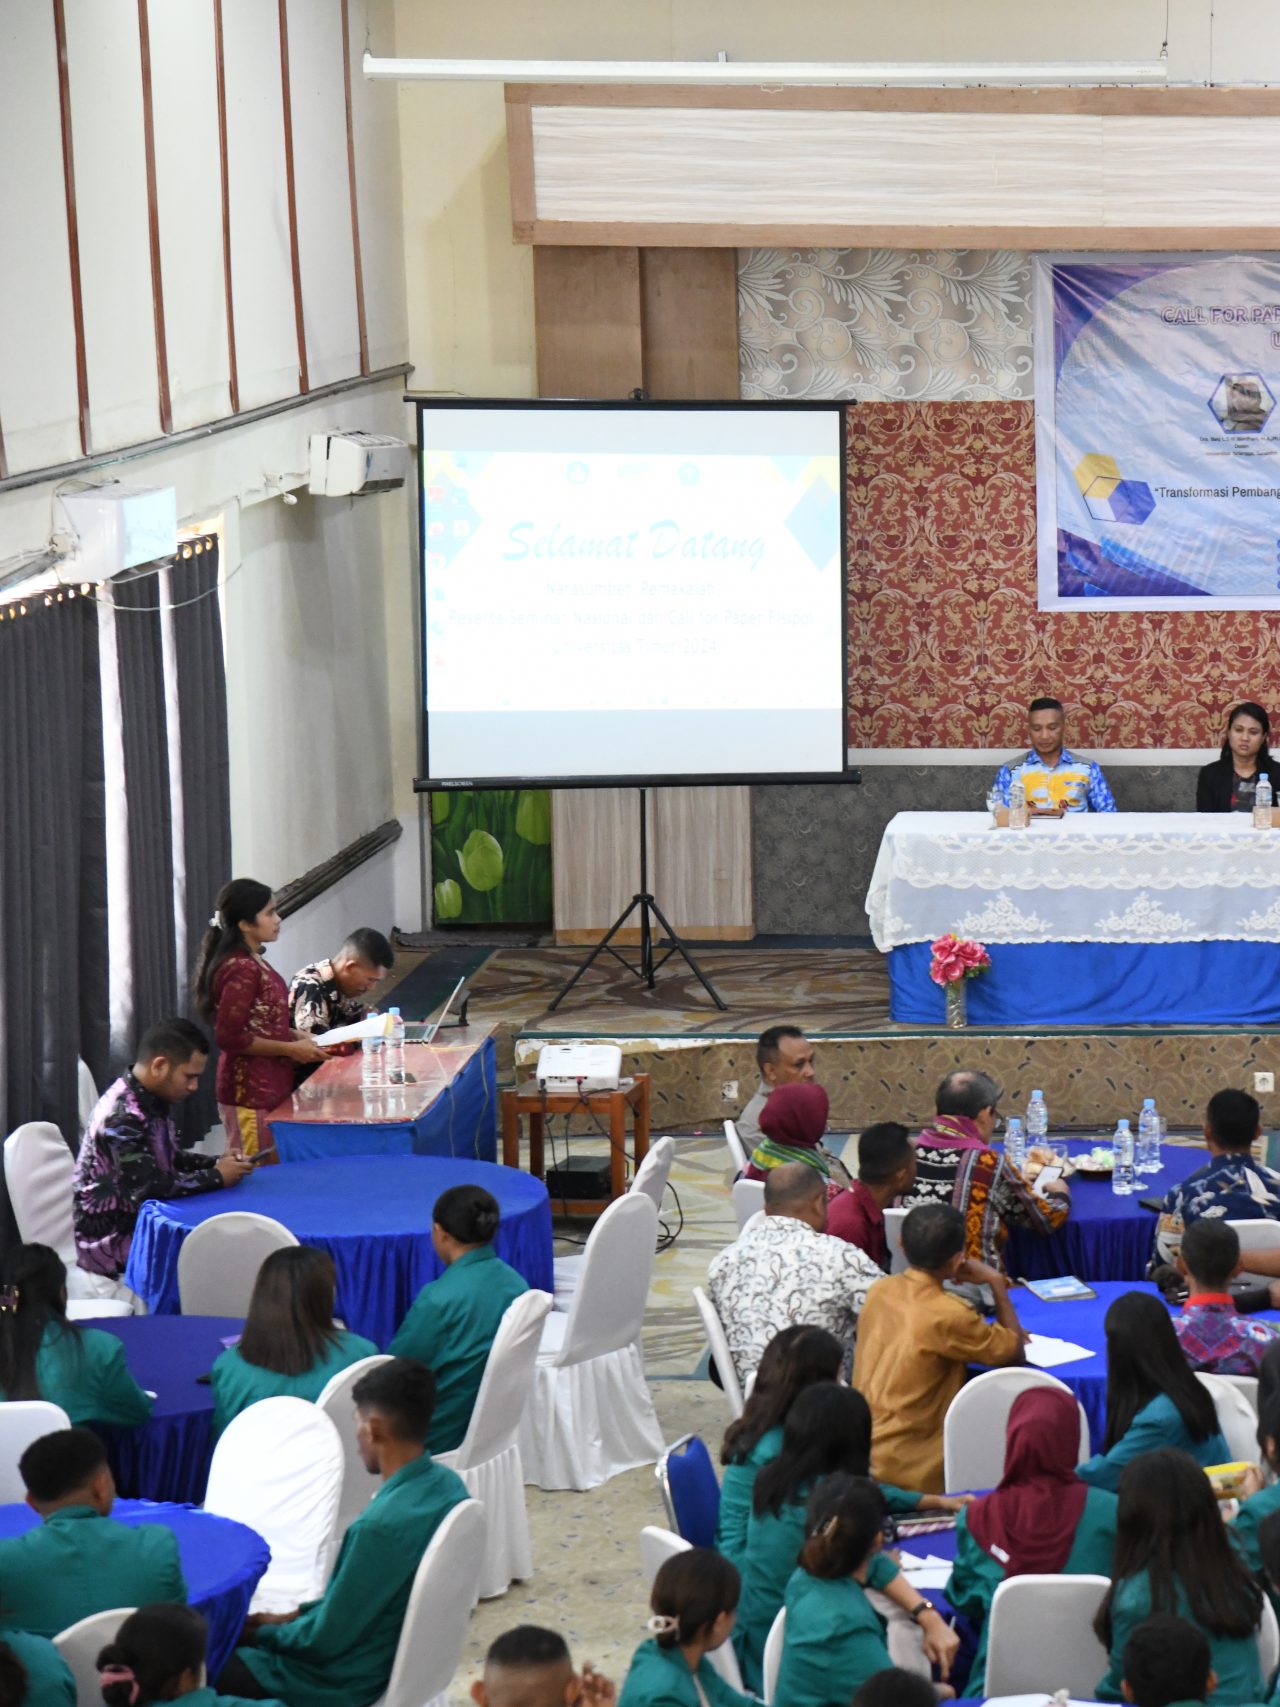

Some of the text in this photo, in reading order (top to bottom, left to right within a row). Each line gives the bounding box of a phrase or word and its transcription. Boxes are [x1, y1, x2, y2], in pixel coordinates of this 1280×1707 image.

[1161, 306, 1206, 325] CALL
[1210, 305, 1248, 324] FOR
[502, 518, 767, 573] Selamat Datang
